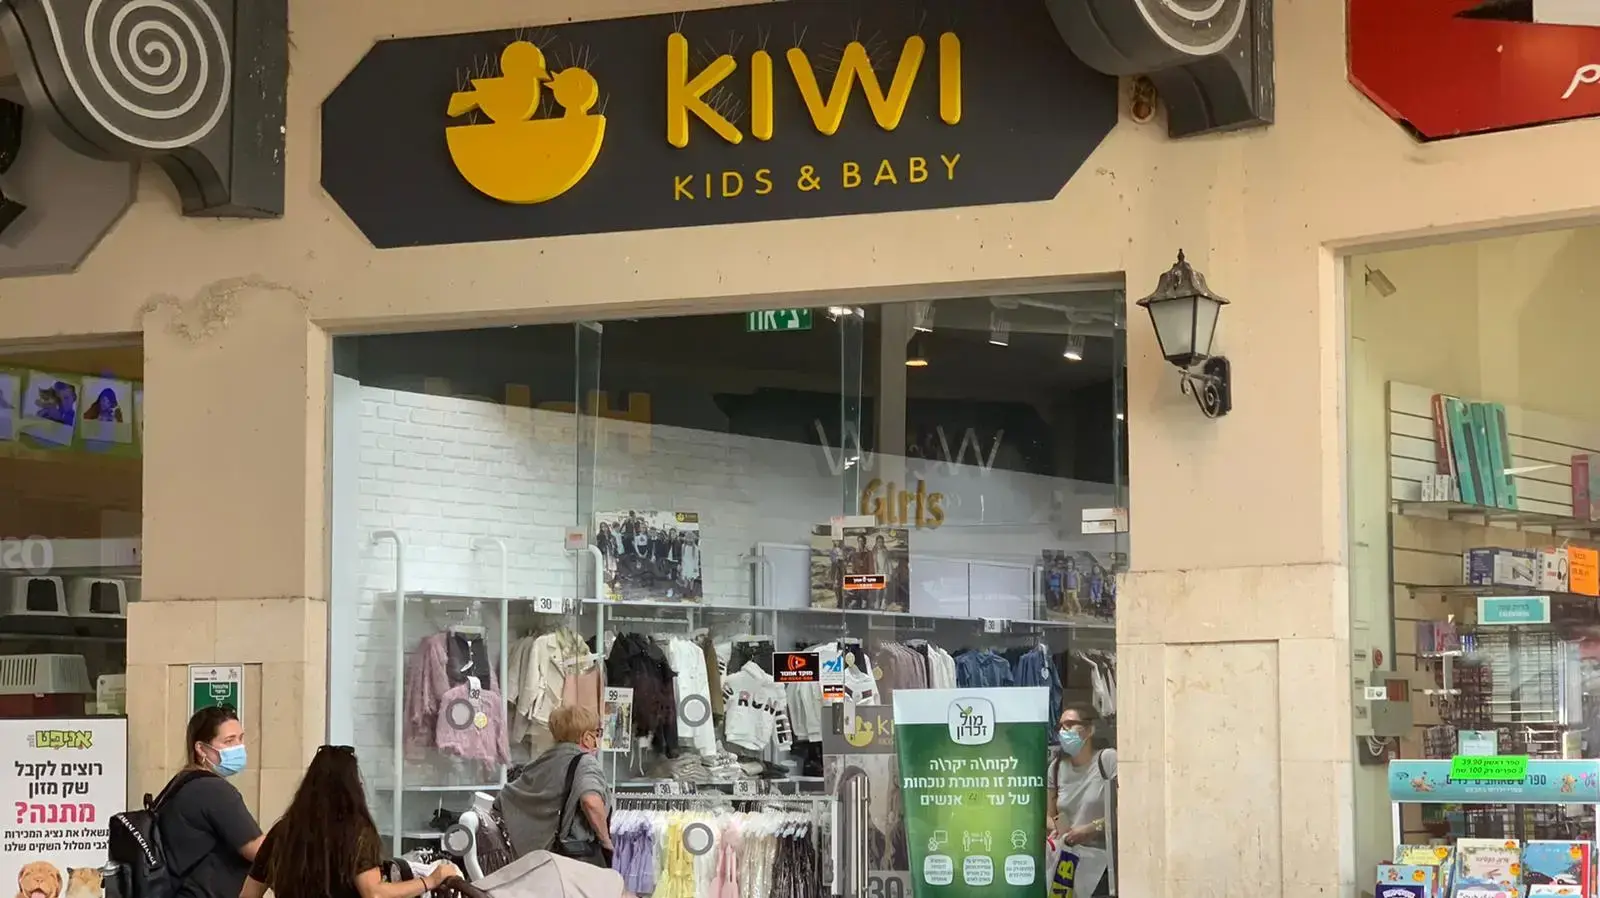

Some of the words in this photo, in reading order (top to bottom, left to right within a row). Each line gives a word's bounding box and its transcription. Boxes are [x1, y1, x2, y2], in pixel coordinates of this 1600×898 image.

[667, 32, 961, 148] KIWI
[674, 169, 773, 200] KIDS
[797, 165, 821, 192] &
[842, 153, 961, 188] BABY
[861, 478, 945, 530] Girls
[540, 598, 552, 609] 30
[609, 690, 618, 701] 99
[960, 711, 984, 726] מול
[957, 725, 988, 741] זכרון
[36, 730, 93, 749] אניפט
[15, 760, 57, 780] לקבל
[61, 763, 103, 776] רוצים
[929, 757, 966, 774] יקר\ה
[970, 756, 1019, 773] לקוח\ה
[904, 777, 945, 789] נוכחות
[948, 777, 990, 788] מותרת
[993, 776, 1004, 788] זו
[1007, 776, 1044, 787] בחנות
[29, 782, 58, 799] מזון
[62, 782, 89, 798] שק
[920, 794, 962, 806] אנשים
[986, 794, 1005, 806] עד
[1008, 792, 1030, 805] של
[15, 801, 95, 824] מתנה?
[4, 829, 43, 839] המכירות
[44, 828, 63, 839] נציג
[66, 828, 80, 838] את
[4, 842, 27, 852] שלנו
[29, 842, 61, 853] השקים
[63, 840, 91, 851] מסלול
[93, 839, 110, 850] גבי
